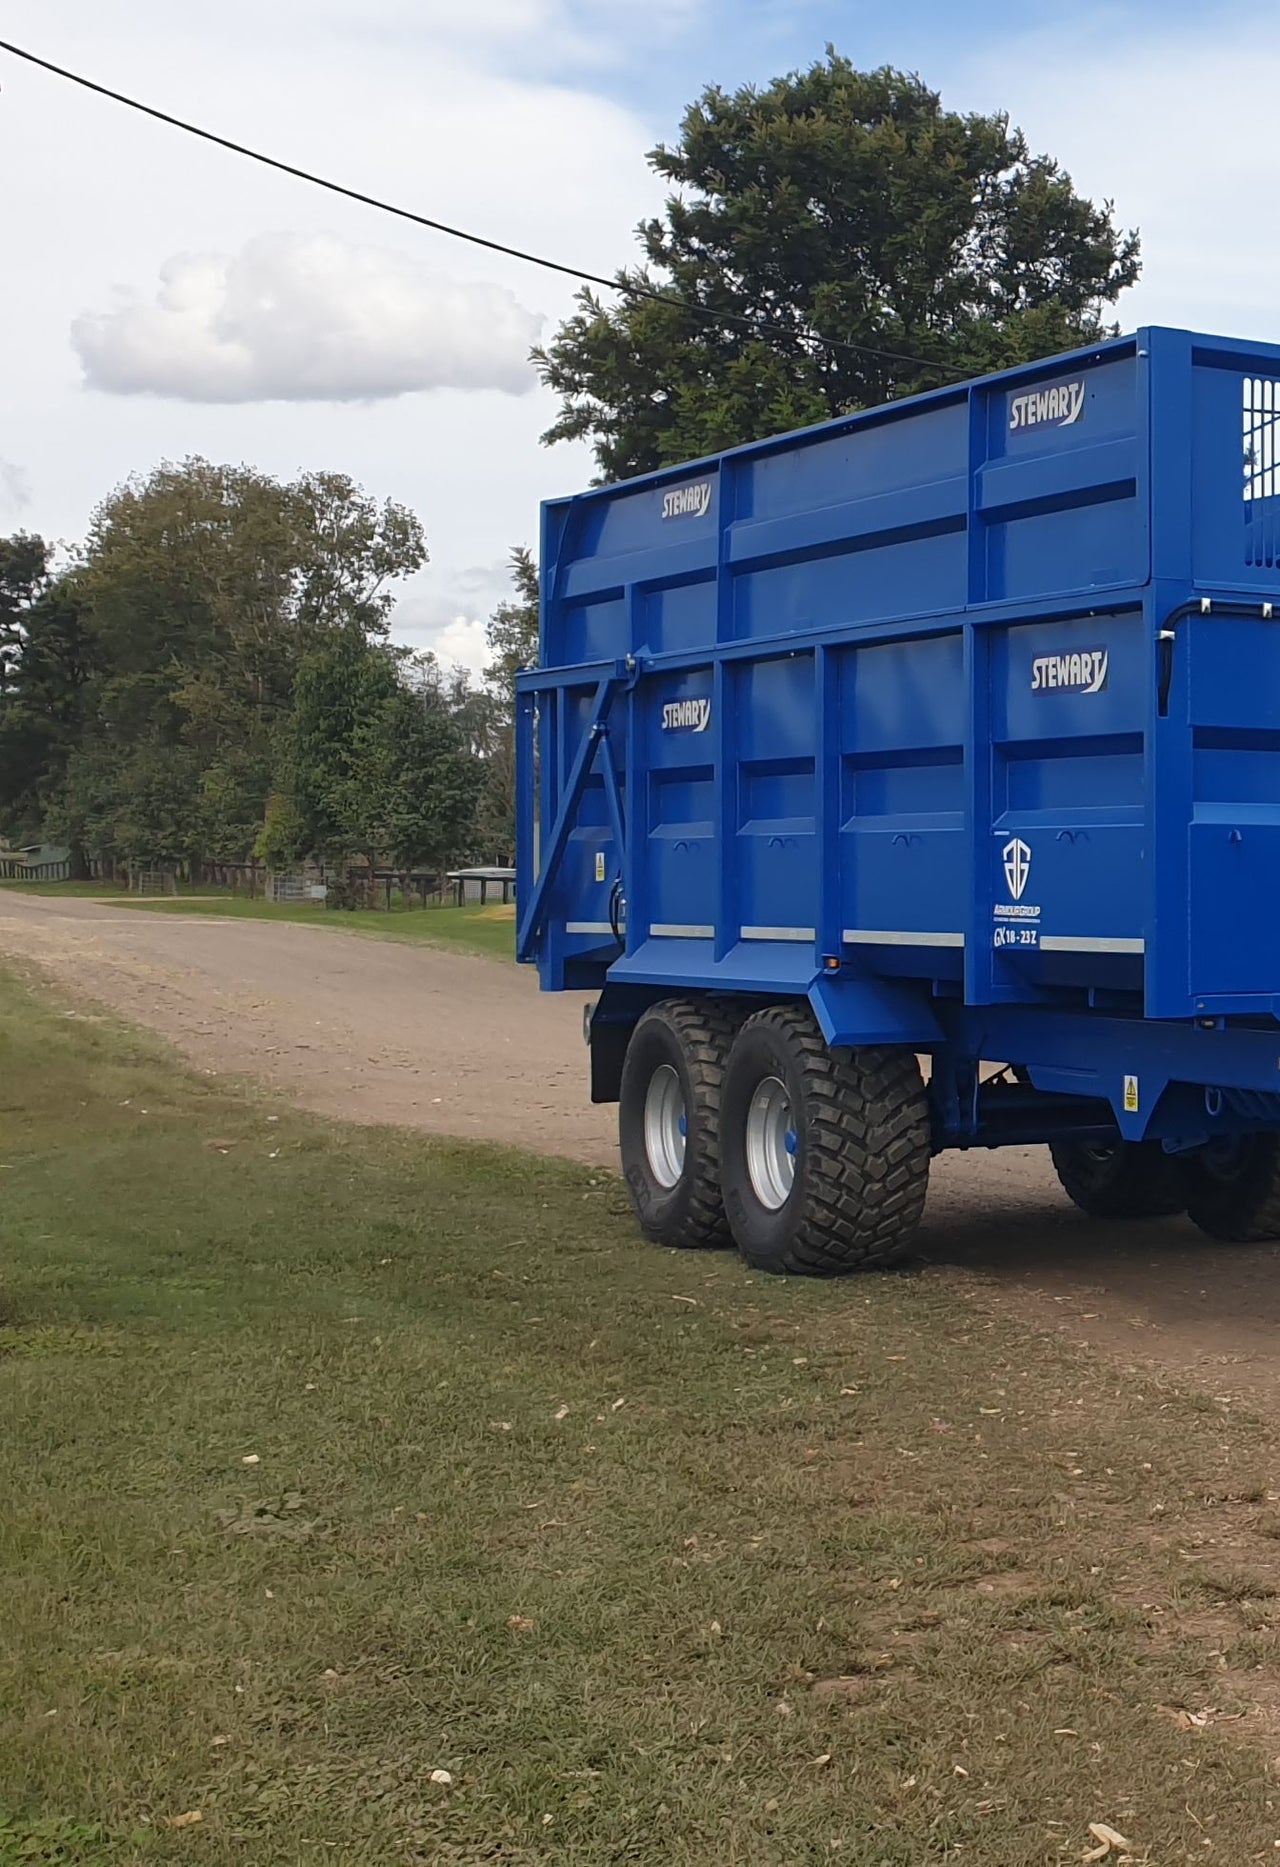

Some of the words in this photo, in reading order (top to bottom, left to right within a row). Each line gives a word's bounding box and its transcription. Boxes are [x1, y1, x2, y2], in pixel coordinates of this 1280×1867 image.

[1009, 380, 1085, 430] STEWART
[661, 483, 712, 518] STEWART
[1031, 648, 1108, 694] STEWART
[661, 697, 711, 732] STEWART
[994, 926, 1006, 947] GX
